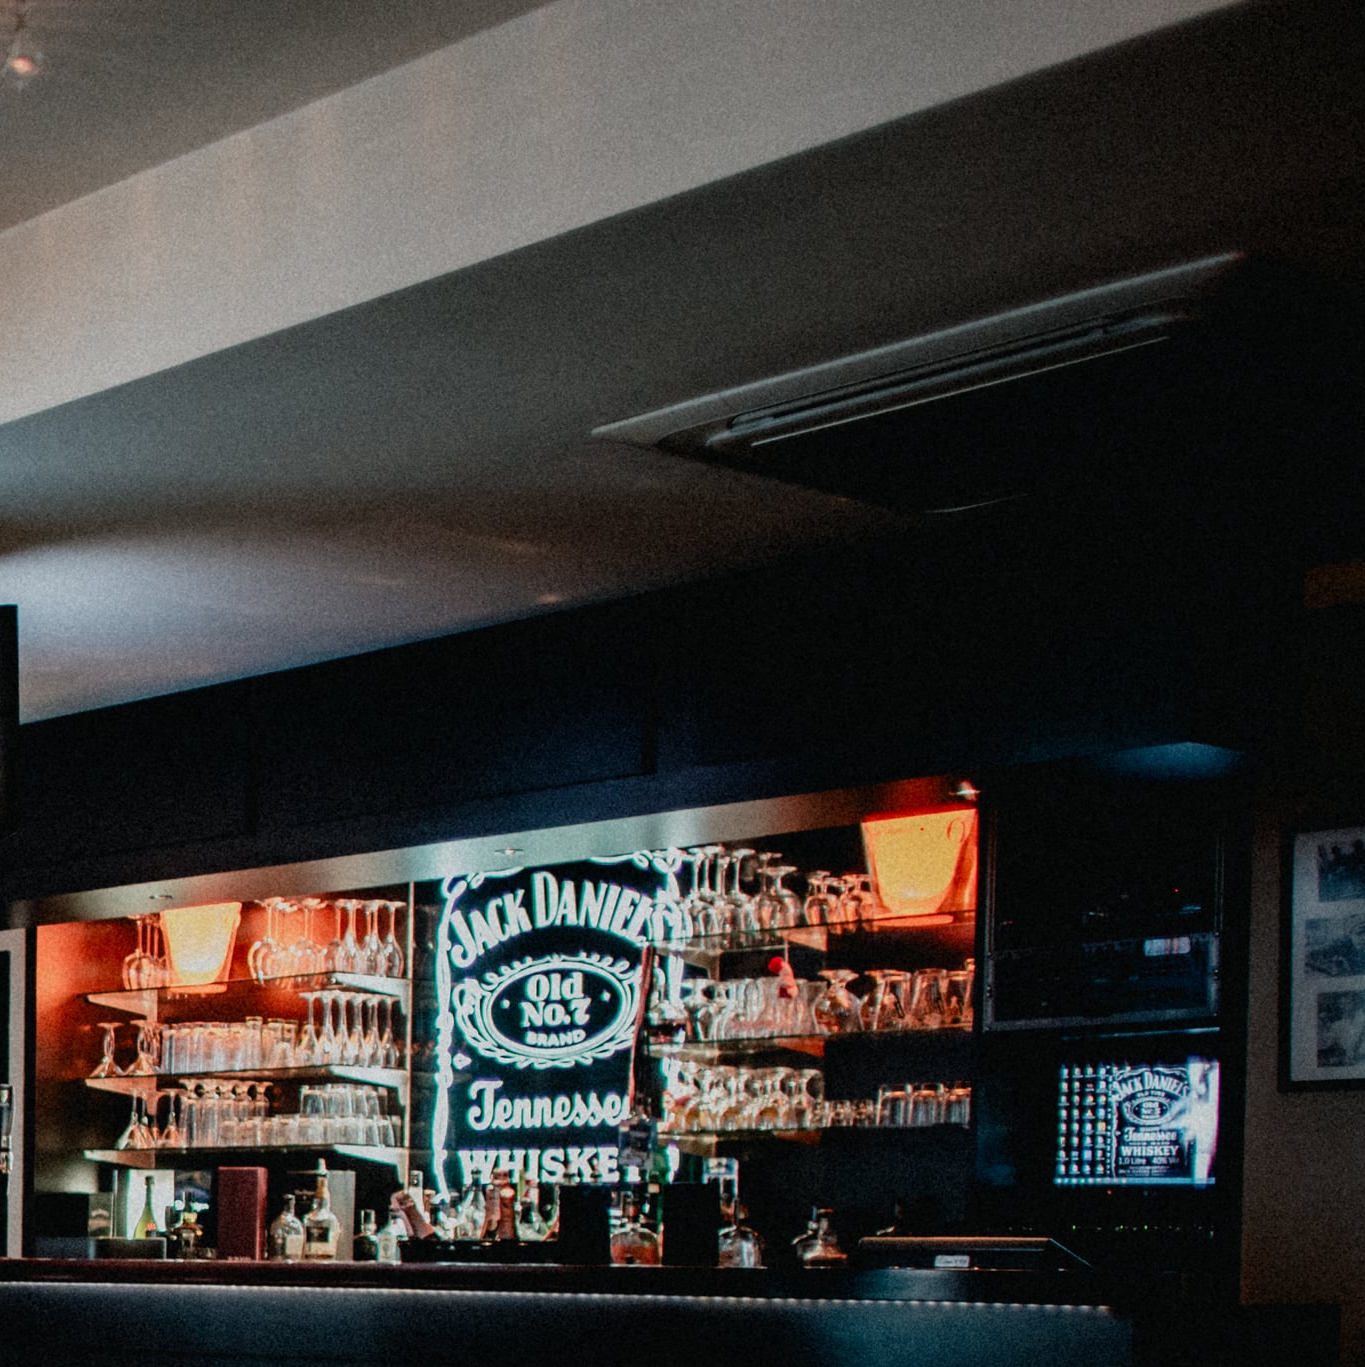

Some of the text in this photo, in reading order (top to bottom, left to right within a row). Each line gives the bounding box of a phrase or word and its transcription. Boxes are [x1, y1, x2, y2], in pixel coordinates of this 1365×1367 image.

[450, 888, 533, 968] JACK
[526, 973, 584, 1001] Old
[525, 1029, 587, 1047] BRAND
[1112, 1076, 1144, 1101] JACK
[1124, 1127, 1177, 1141] Tennessee
[1121, 1145, 1180, 1156] WHISKEY
